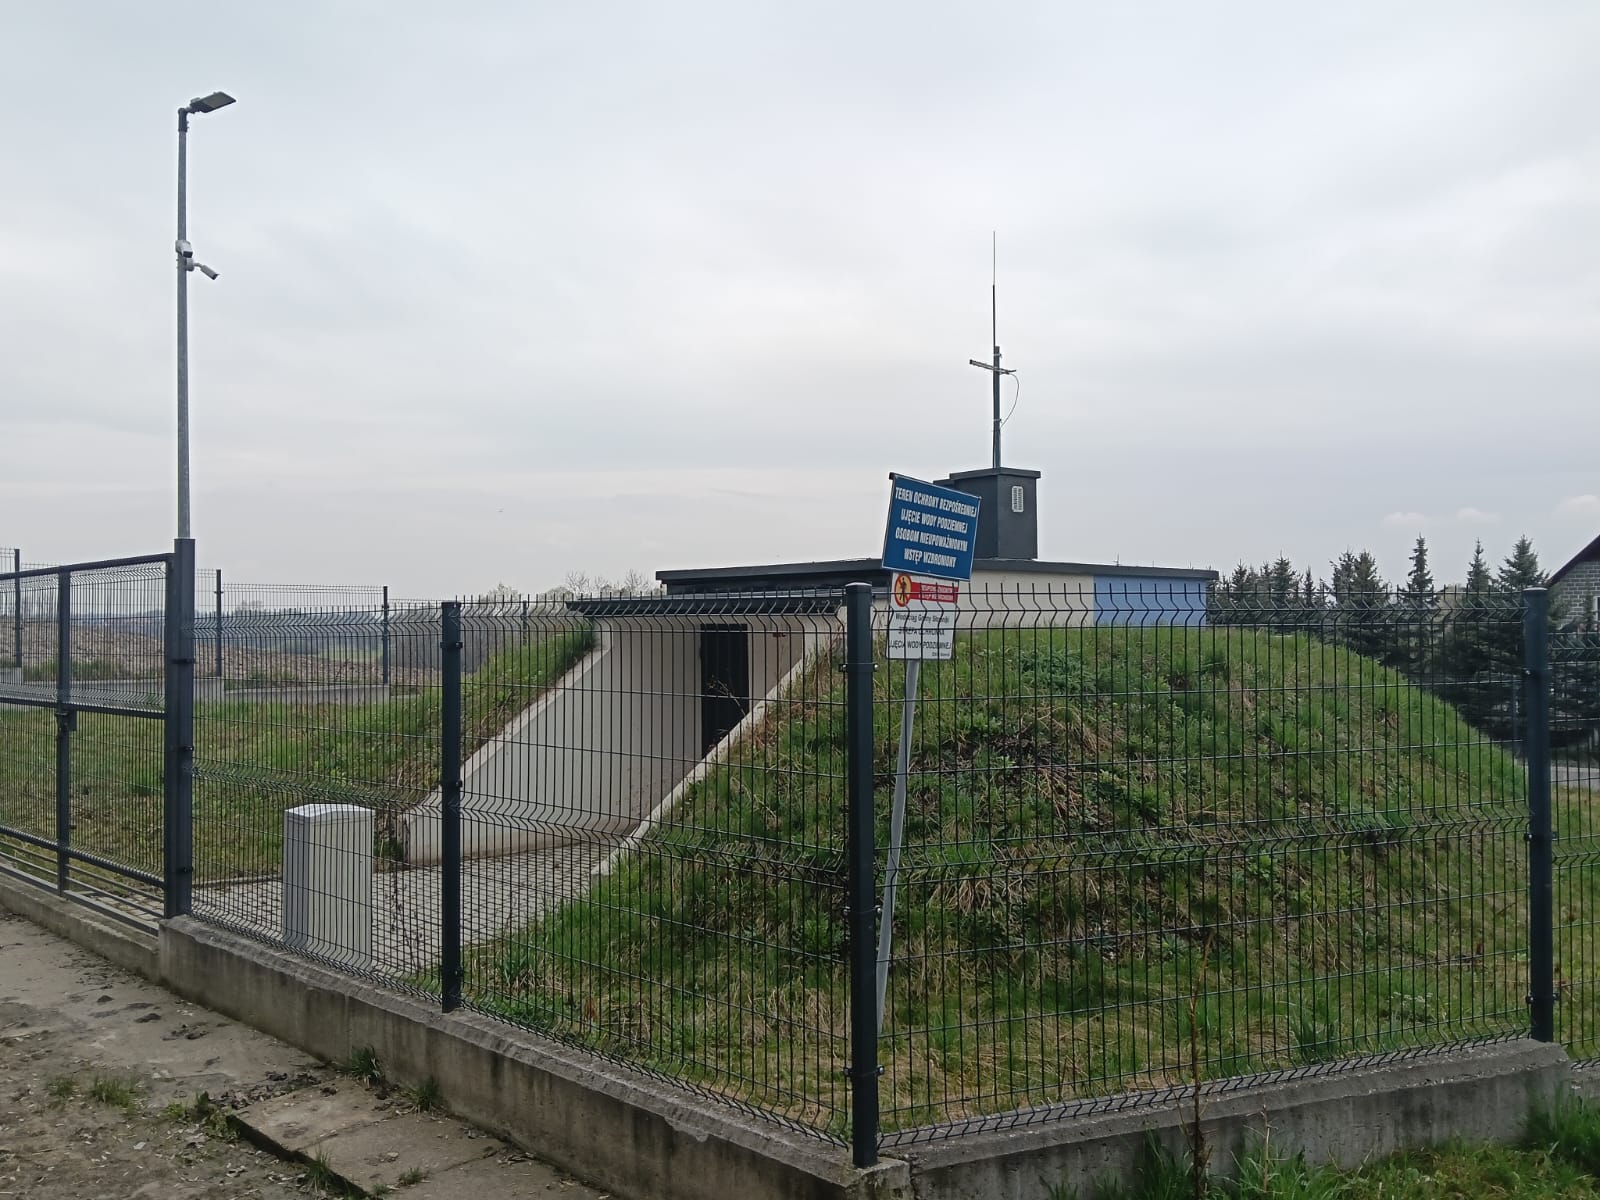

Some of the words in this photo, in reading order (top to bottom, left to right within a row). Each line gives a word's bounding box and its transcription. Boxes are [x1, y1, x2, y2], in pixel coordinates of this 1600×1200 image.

[895, 487, 913, 501] TEREN
[914, 492, 939, 507] OCHRONY
[940, 498, 977, 517] BEZPOŚREDNIEJ
[901, 509, 920, 524] UJĘCIE
[922, 513, 937, 527] WODY
[937, 517, 968, 533] PODZIEMNEJ
[895, 527, 920, 543] OSOBOM
[920, 532, 968, 552] NIEUPOWAŻNIONYM
[904, 548, 923, 565] WSTĘP
[923, 552, 957, 567] WZBRONIONY
